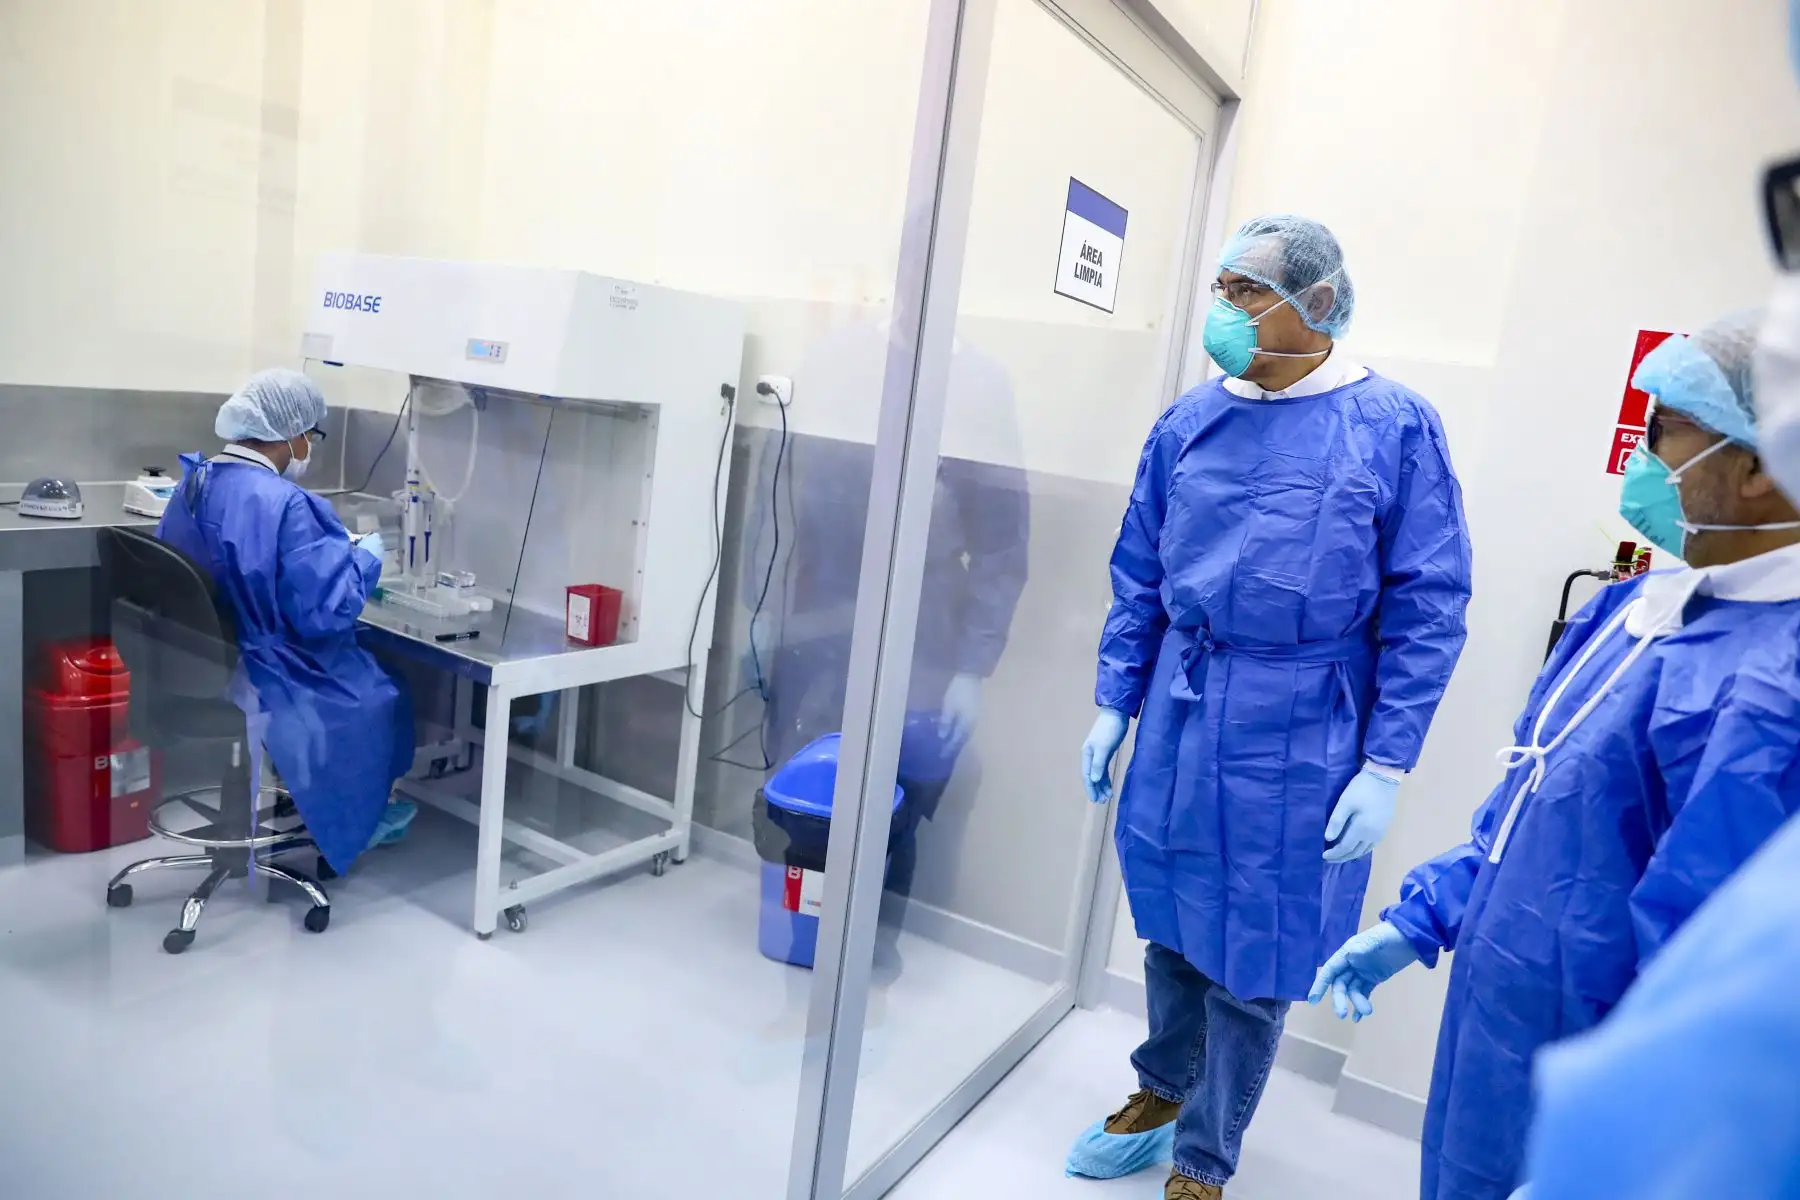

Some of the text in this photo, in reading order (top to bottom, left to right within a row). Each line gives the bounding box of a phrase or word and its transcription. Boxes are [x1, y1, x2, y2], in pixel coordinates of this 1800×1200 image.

[1080, 240, 1102, 267] ÁREA
[1074, 262, 1102, 288] LIMPIA
[323, 291, 382, 313] BIOBASE
[1620, 432, 1645, 444] EXT
